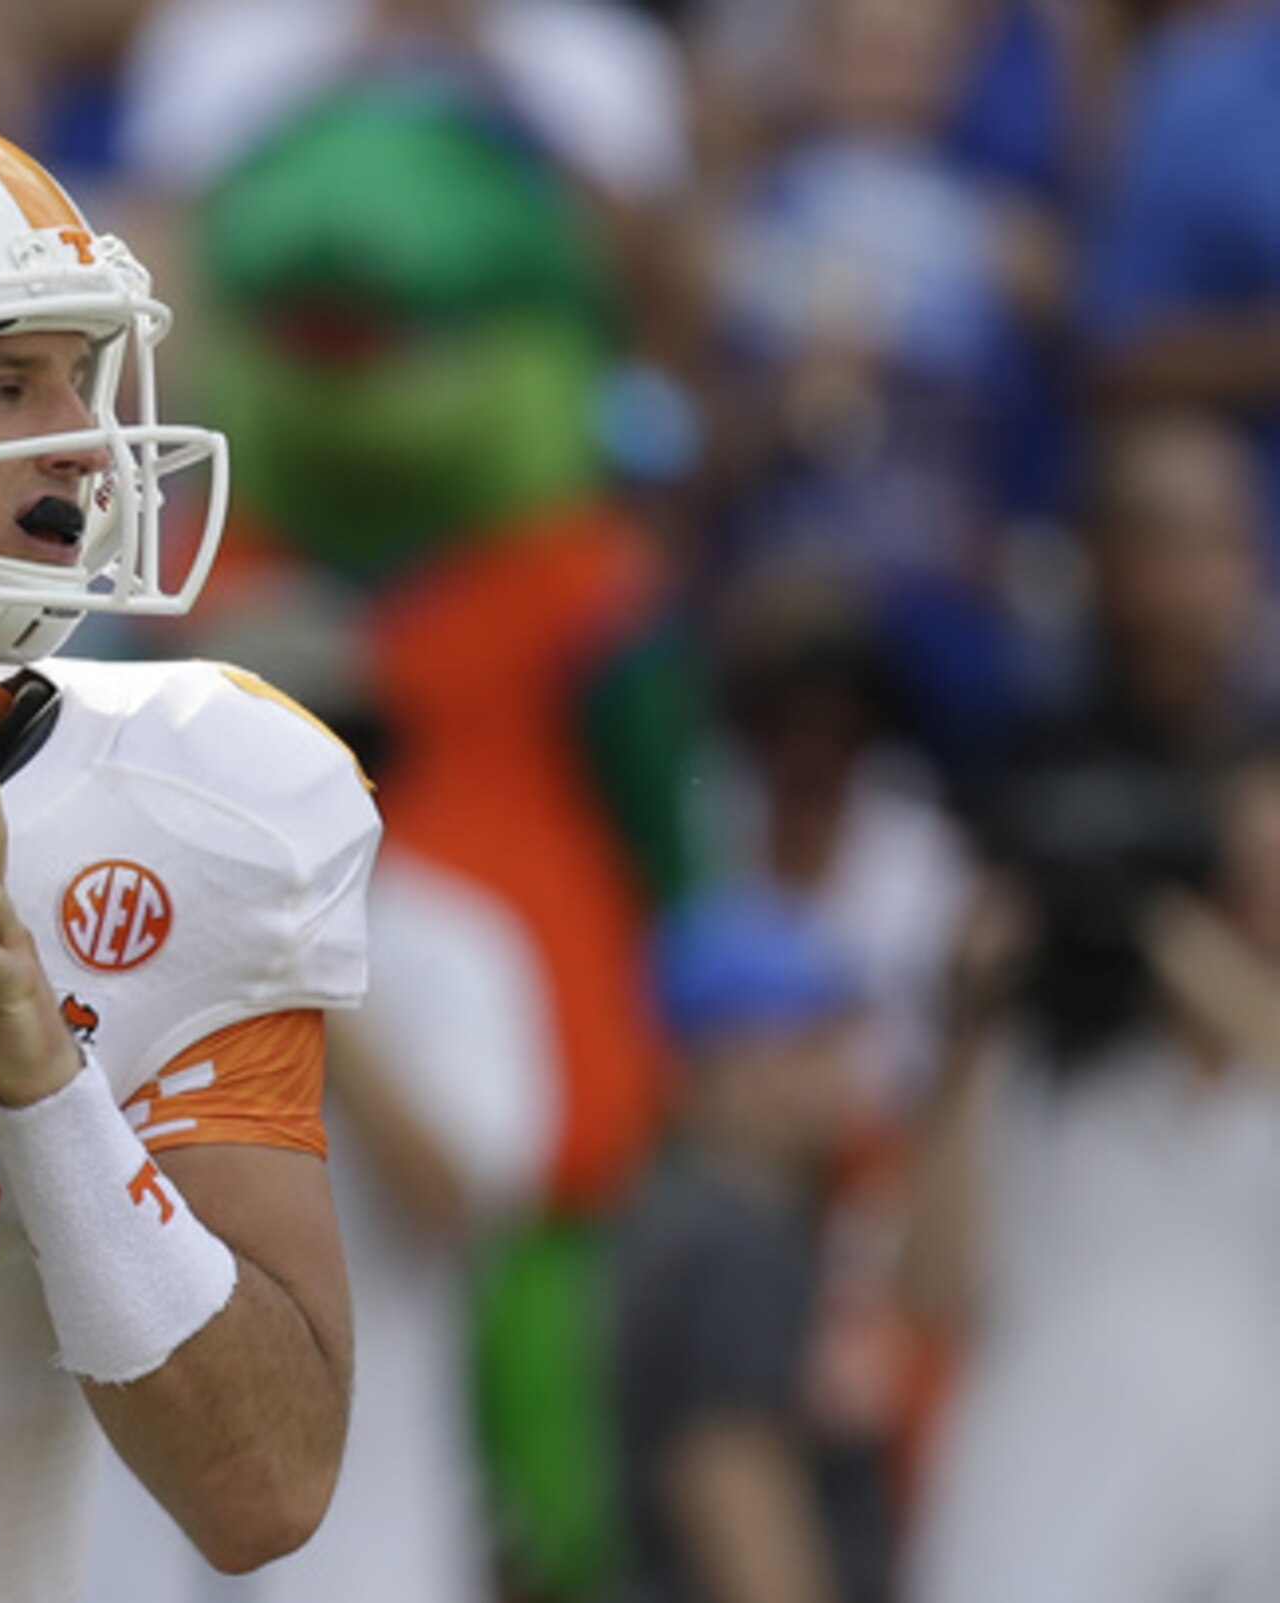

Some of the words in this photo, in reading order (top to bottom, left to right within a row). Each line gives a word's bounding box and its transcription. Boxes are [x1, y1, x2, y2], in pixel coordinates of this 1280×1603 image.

[59, 231, 95, 264] T
[69, 864, 167, 966] SEC
[126, 1159, 174, 1225] T
